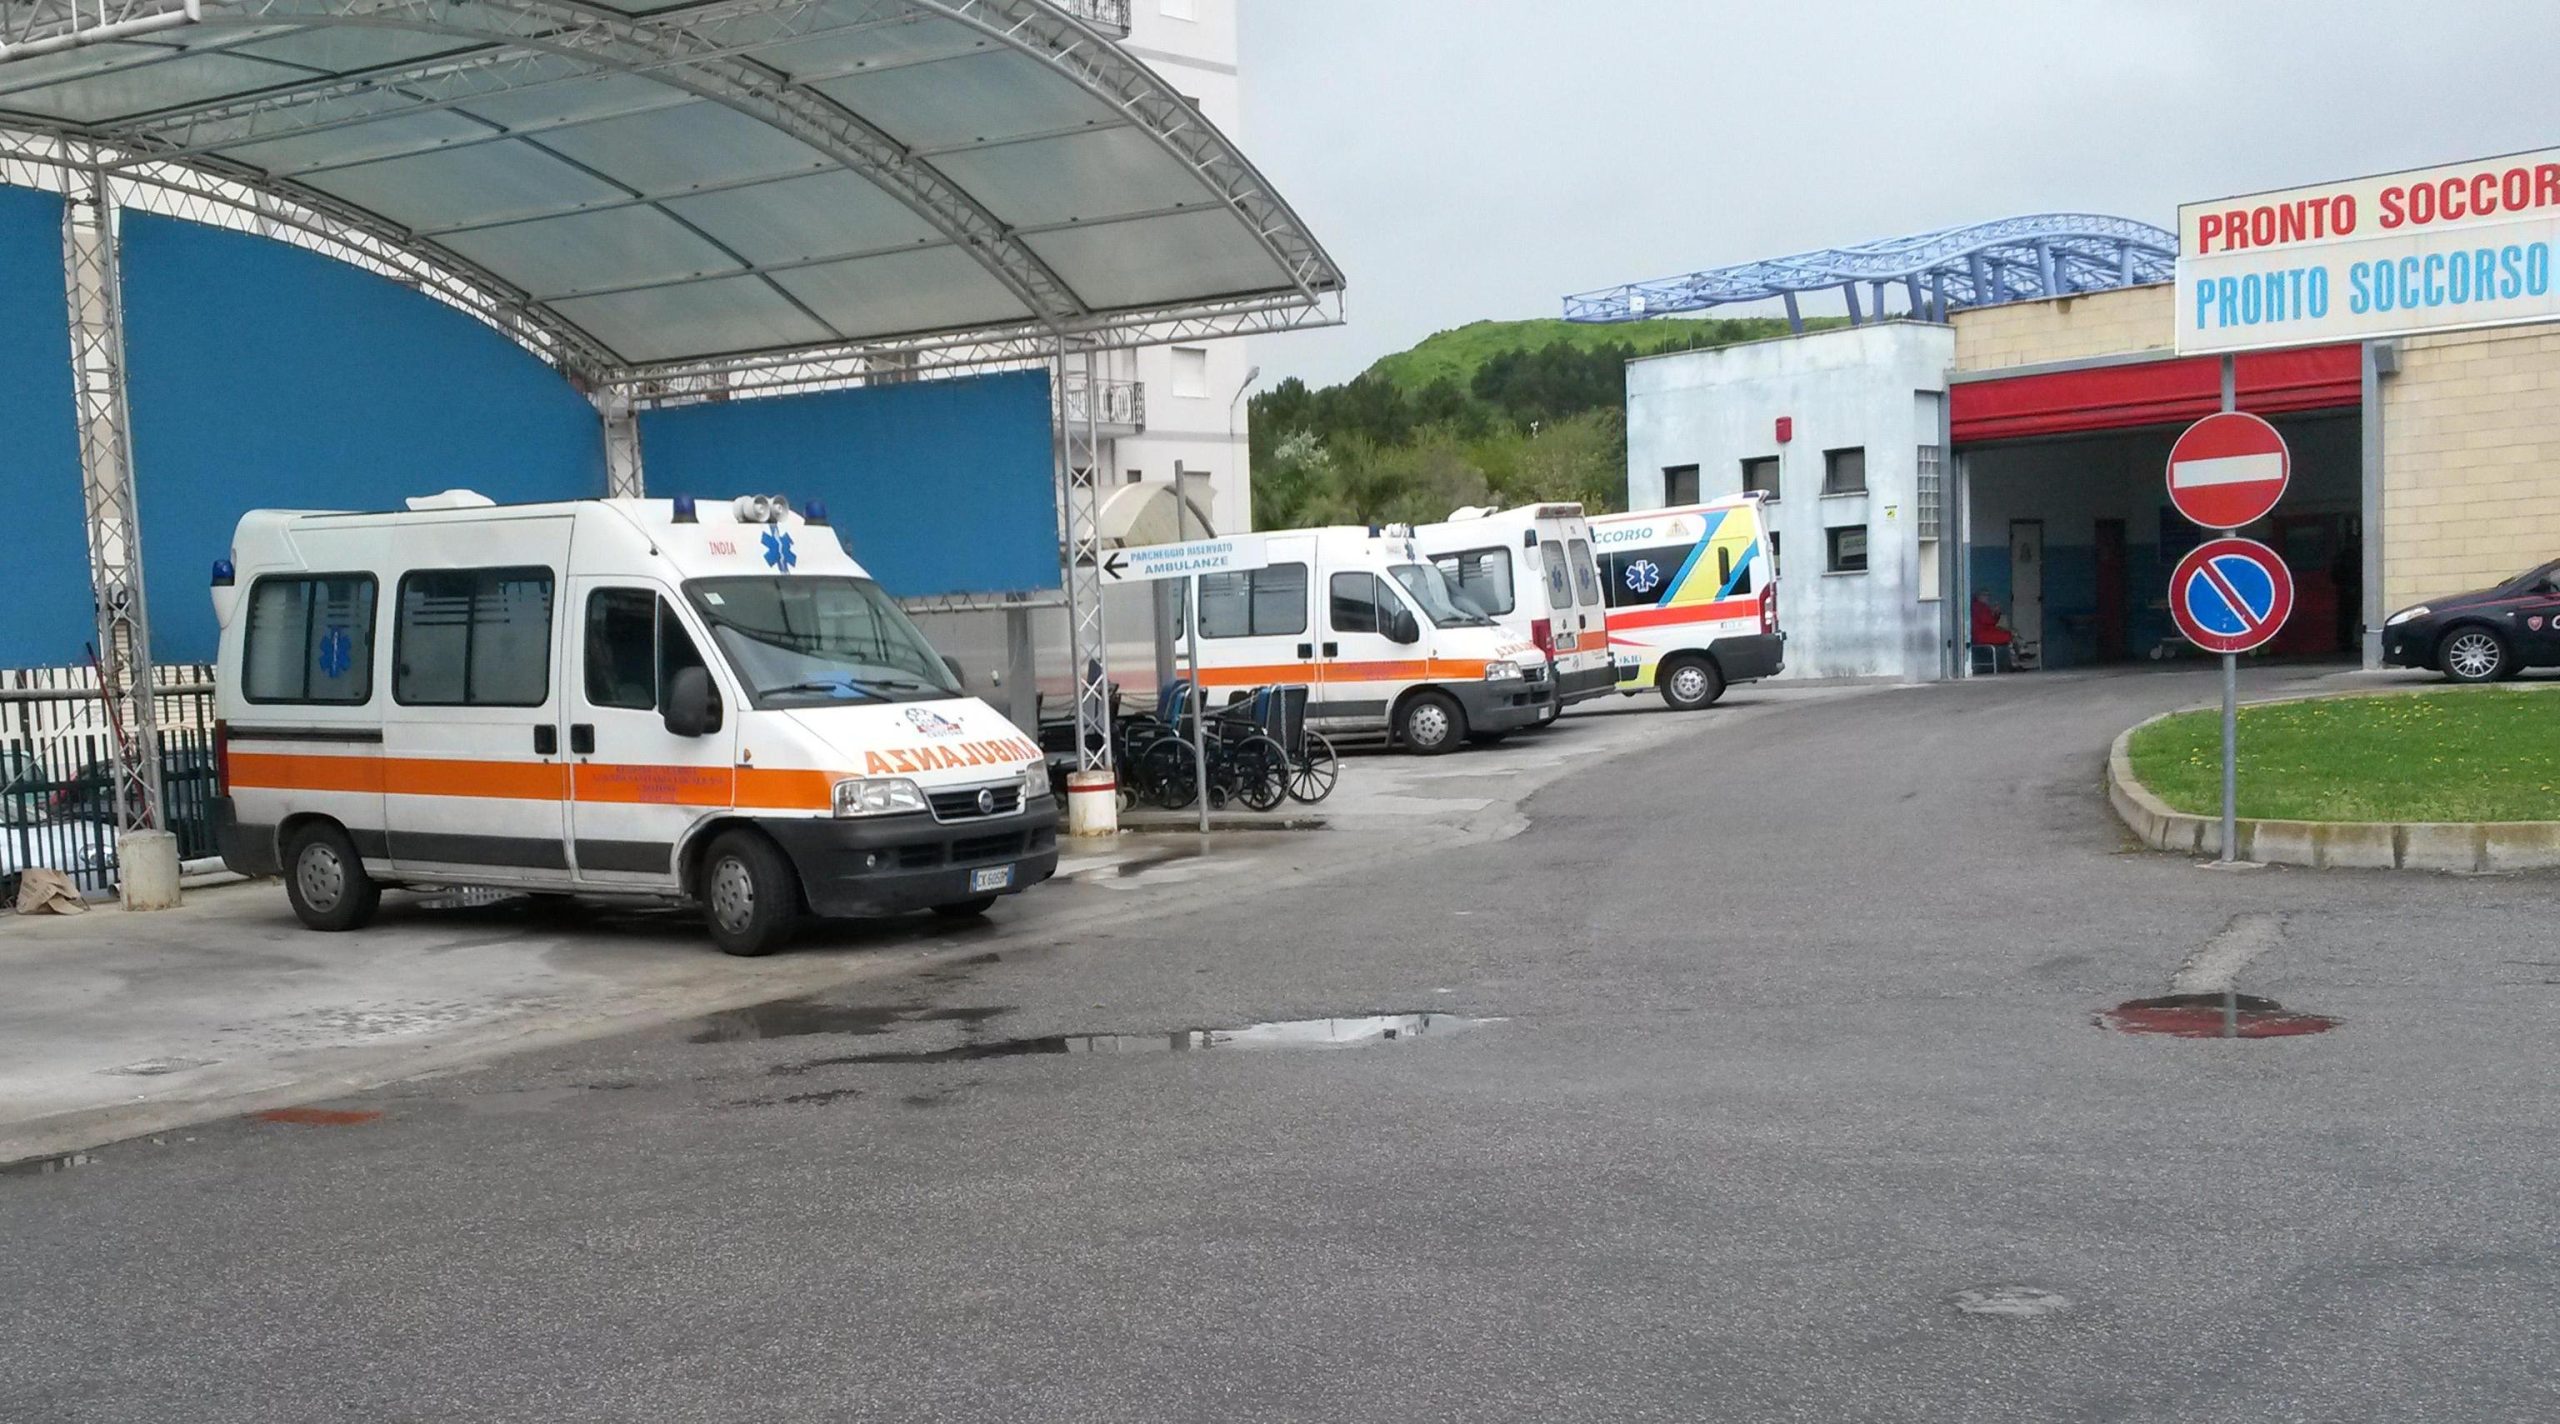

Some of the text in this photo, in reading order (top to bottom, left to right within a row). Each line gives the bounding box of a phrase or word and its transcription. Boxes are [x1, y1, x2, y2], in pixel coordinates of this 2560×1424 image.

[2199, 163, 2560, 254] PRONTO SOCCOR
[2197, 242, 2549, 329] PRONTO SOCCORSO
[709, 541, 737, 556] INDIA
[1130, 542, 1233, 562] PARCHEGGIO RISERVATO
[1144, 556, 1229, 575] AMBULANZE
